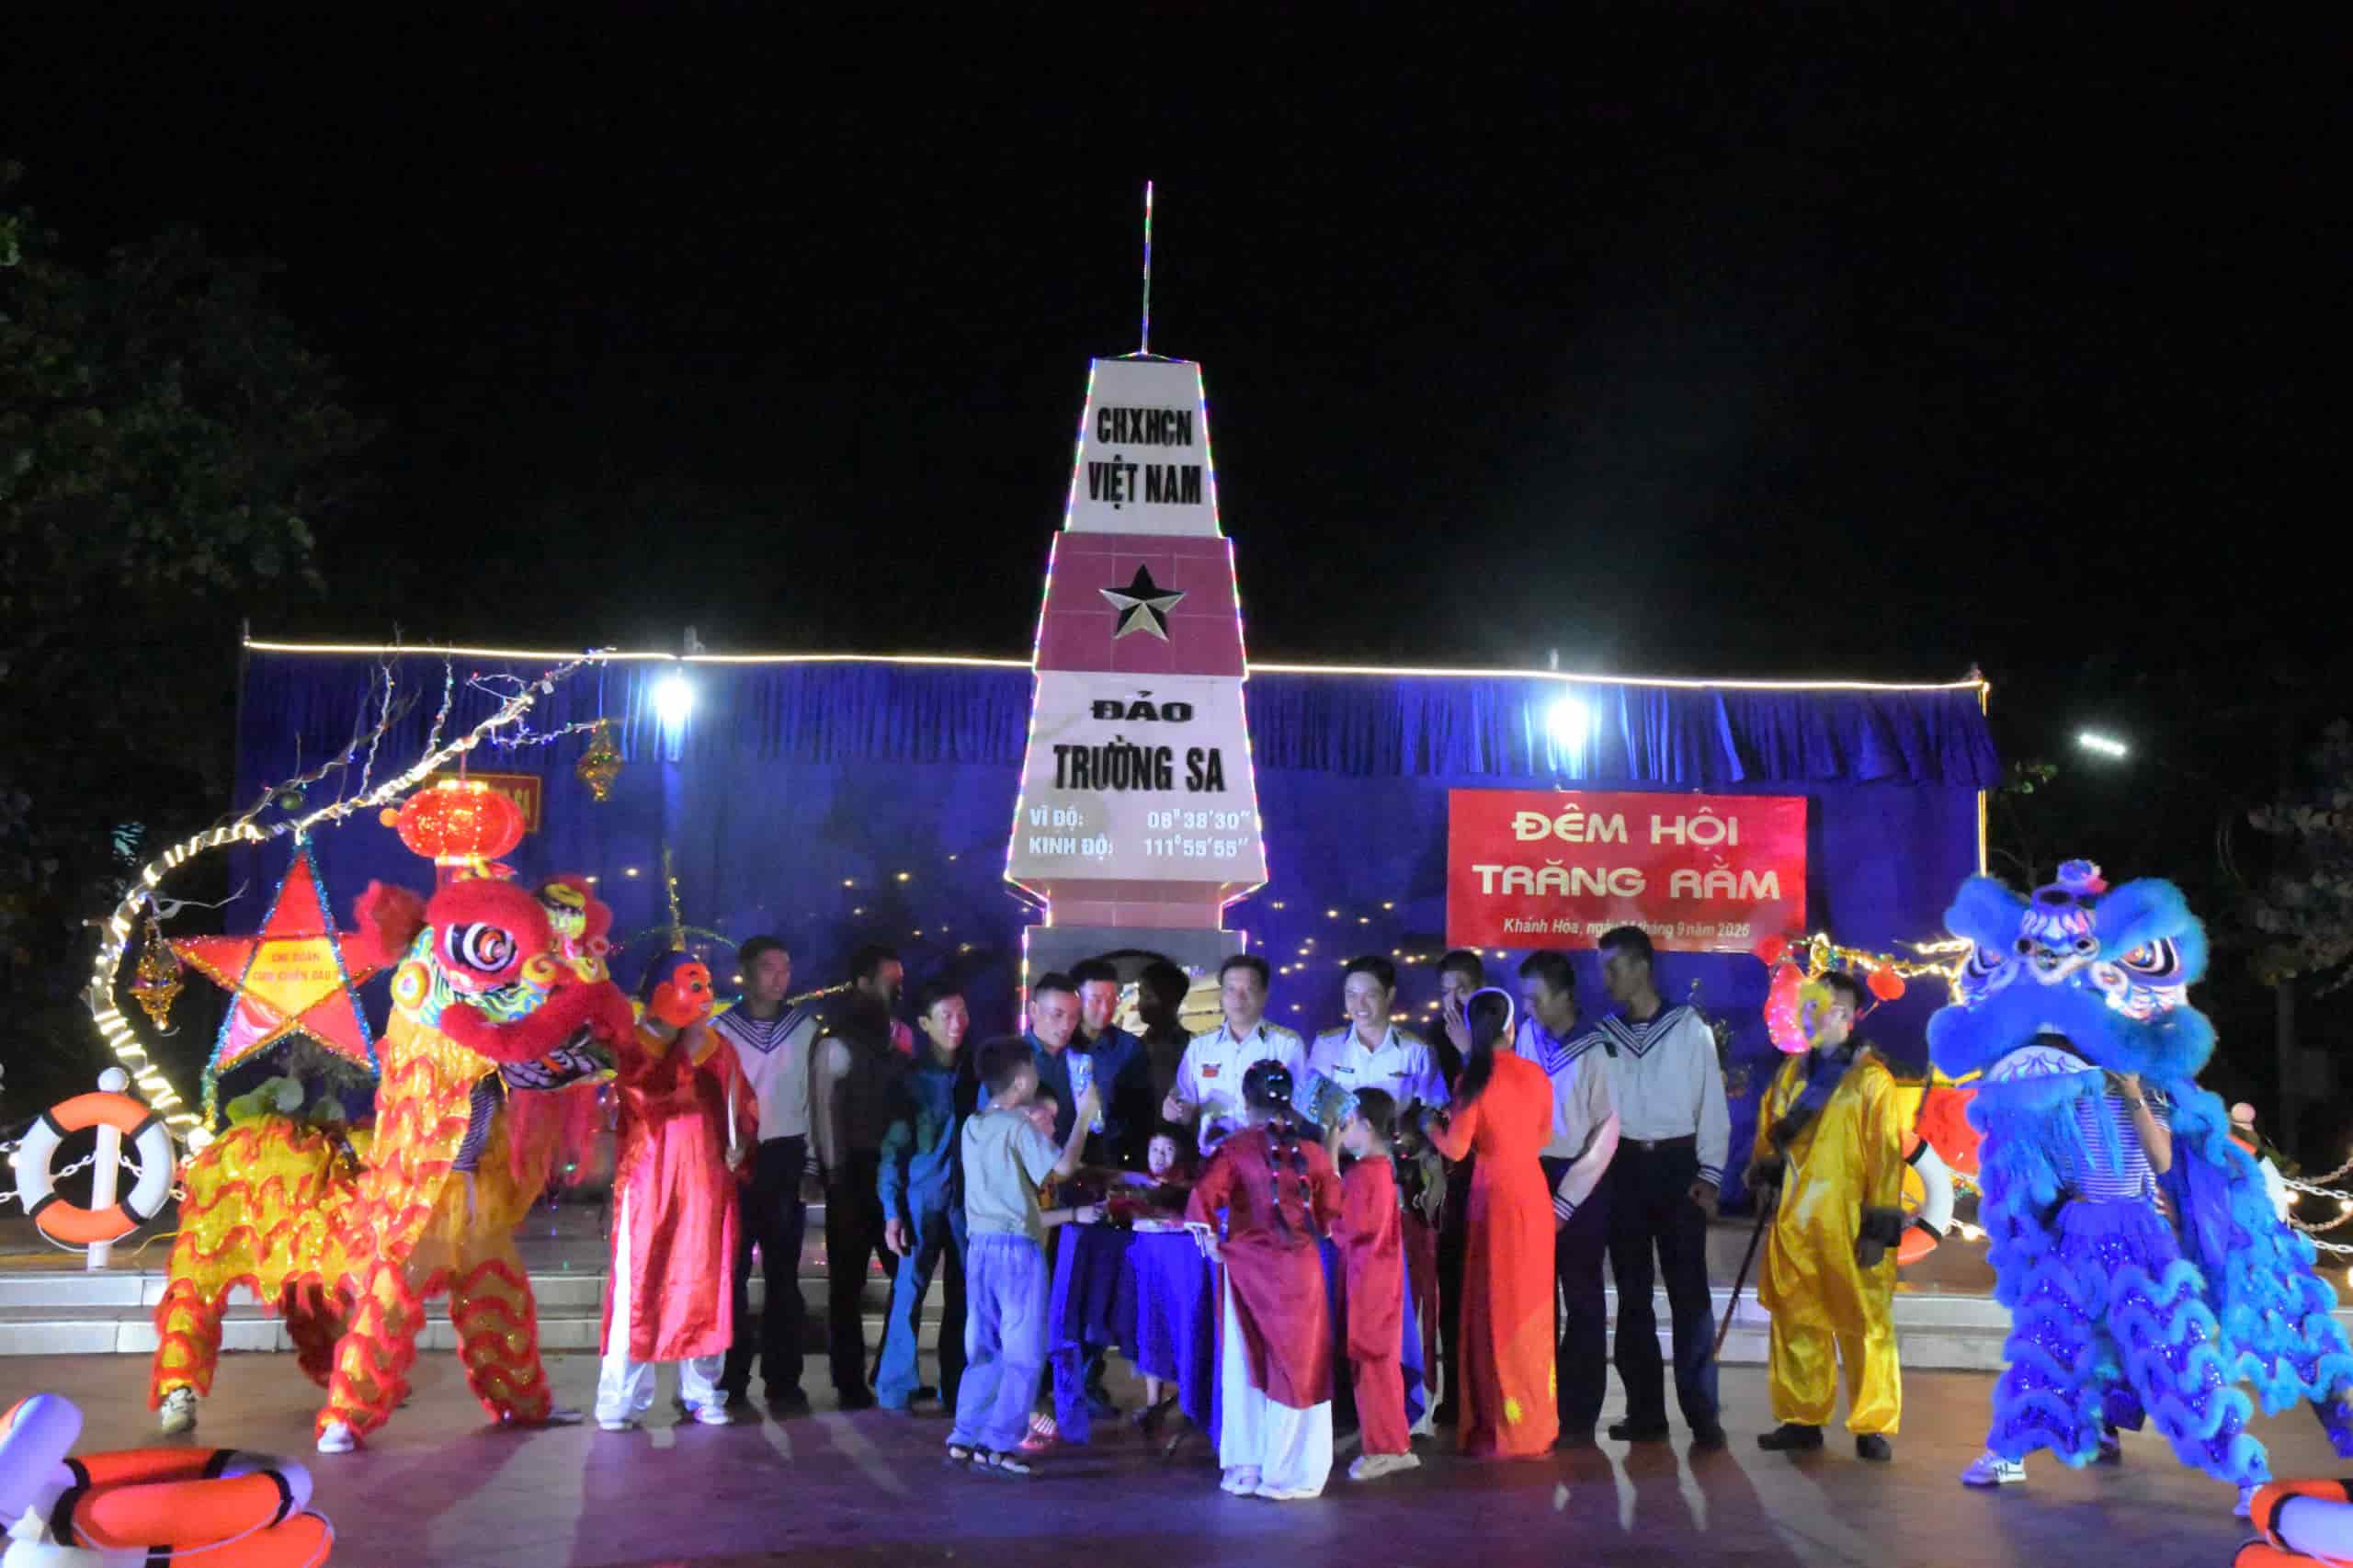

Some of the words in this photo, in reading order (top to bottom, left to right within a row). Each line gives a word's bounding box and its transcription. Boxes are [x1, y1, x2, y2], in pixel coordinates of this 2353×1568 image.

[1097, 407, 1192, 446] CHXHCN
[1088, 454, 1138, 509] VIỆT
[1145, 463, 1201, 505] NAM
[1090, 690, 1193, 723] ĐẢO
[1053, 734, 1174, 791] TRƯỜNG
[1186, 746, 1226, 792] SA
[1029, 837, 1076, 854] KINH
[1510, 802, 1629, 845] ĐÊM
[1650, 806, 1739, 852] HỘI
[1472, 858, 1646, 898] TRĂNG
[1669, 855, 1780, 900] RẰM
[1503, 915, 1548, 934] Khánh
[1677, 922, 1685, 937] 9
